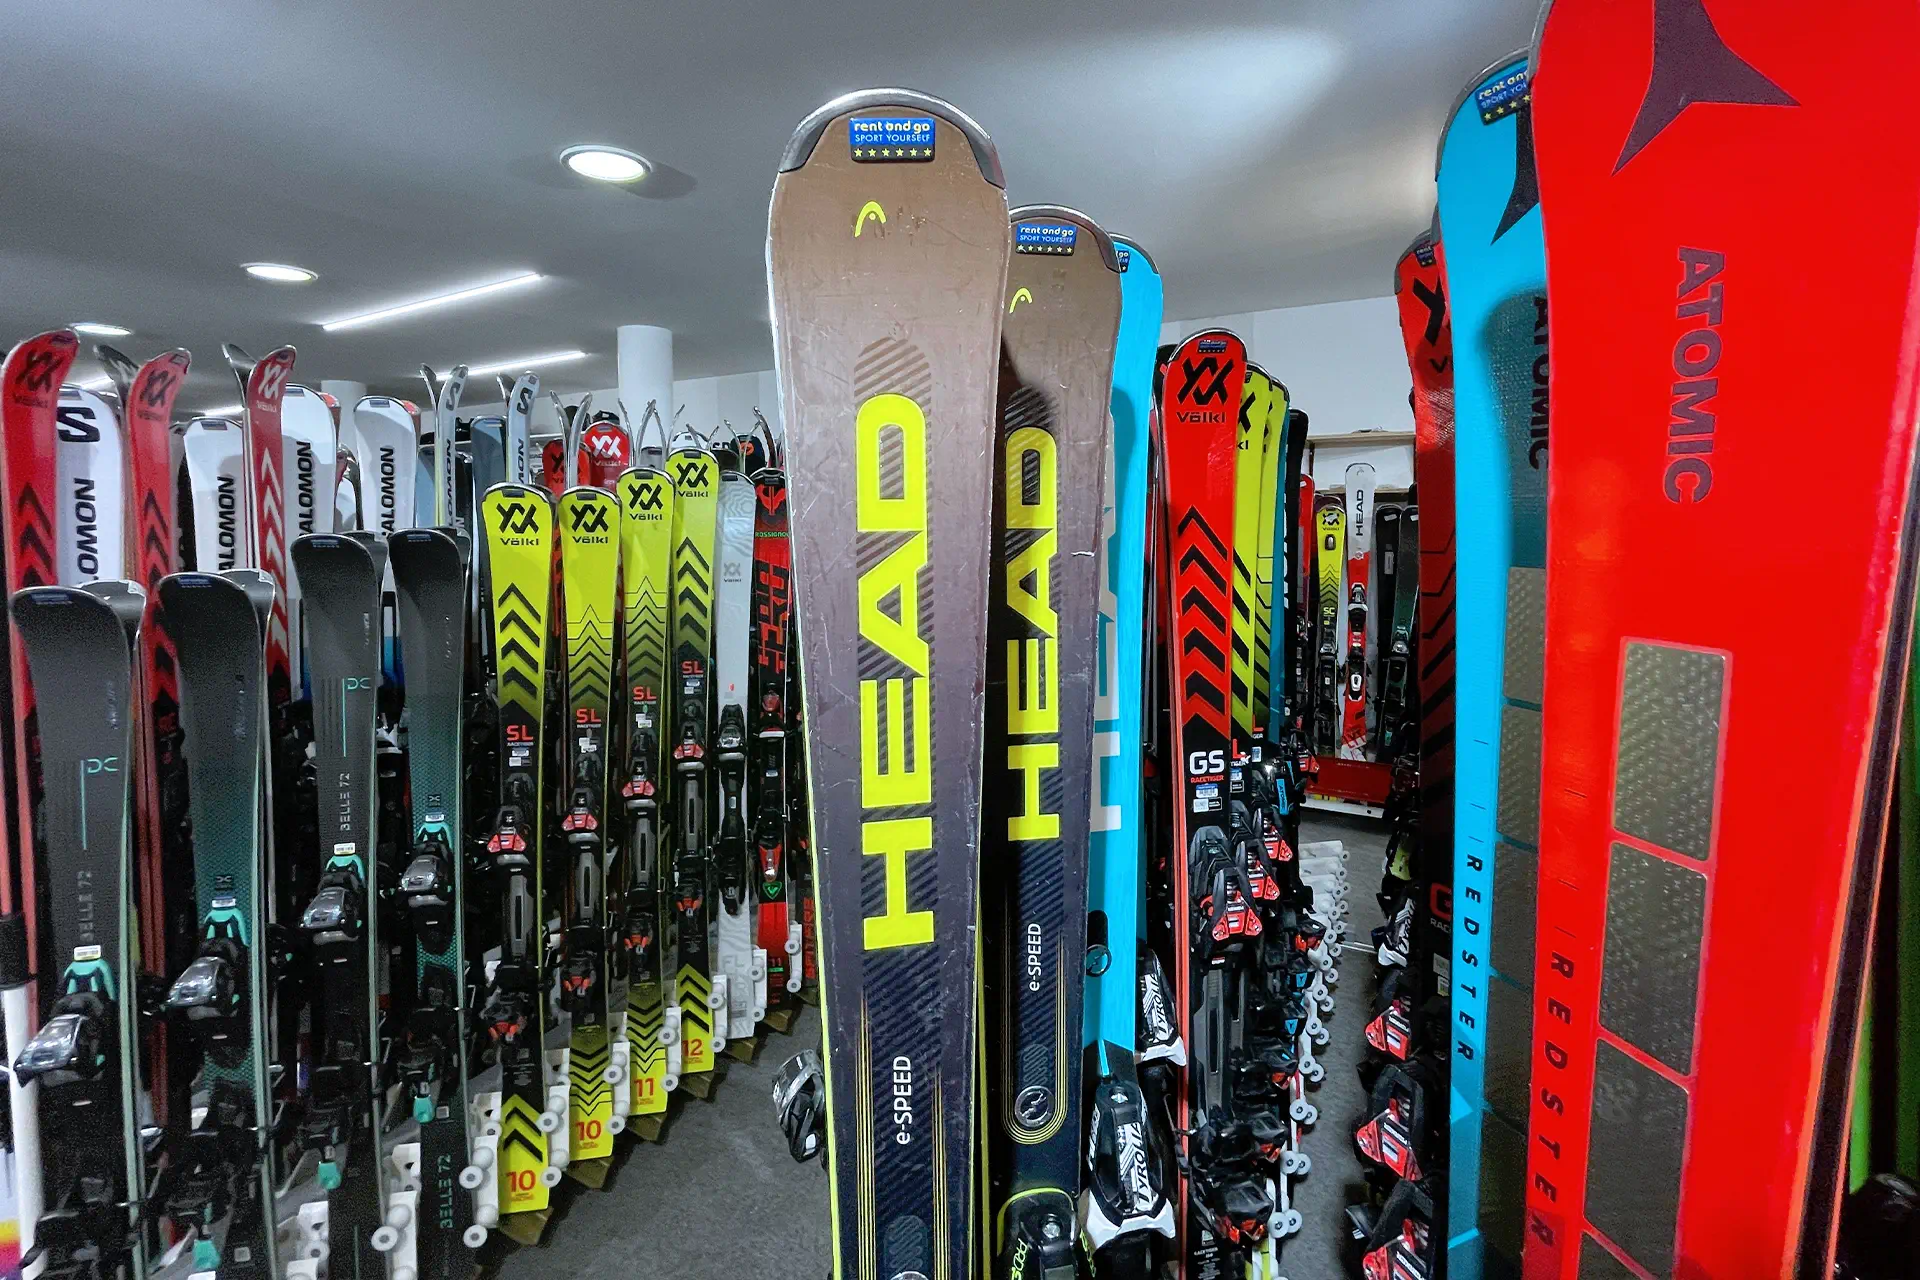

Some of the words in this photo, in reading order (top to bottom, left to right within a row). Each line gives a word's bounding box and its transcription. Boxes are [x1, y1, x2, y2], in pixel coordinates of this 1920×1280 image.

[1479, 81, 1505, 100] rent
[1507, 70, 1528, 85] an
[854, 121, 883, 131] rent
[886, 120, 911, 131] and
[913, 123, 931, 134] go
[855, 134, 883, 142] SPORT
[886, 134, 930, 142] YOURSELF
[1020, 226, 1041, 234] rent
[1042, 227, 1061, 235] and
[1662, 245, 1726, 505] ATOMIC
[1176, 412, 1227, 424] Völkl
[299, 441, 313, 535] ALOMON
[381, 447, 395, 536] ALOMON
[218, 476, 236, 570] ALOMON
[629, 513, 663, 521] Völkl
[1356, 489, 1364, 537] HEAD
[73, 478, 98, 576] OMON
[501, 538, 540, 546] Völkl
[572, 535, 609, 544] Völkl
[1005, 426, 1059, 842] HEAD
[681, 660, 704, 674] SL
[856, 393, 934, 950] HEAD
[633, 686, 657, 700] SL
[576, 708, 602, 723] SL
[506, 725, 534, 741] SL
[1189, 749, 1225, 775] GS
[1027, 923, 1042, 992] e-SPEED
[1457, 853, 1484, 1062] REDSTER
[682, 1038, 704, 1057] 12
[634, 1077, 655, 1097] 11
[893, 1055, 912, 1145] e-SPEED
[1529, 951, 1575, 1249] REDSTER
[576, 1119, 602, 1141] 10
[506, 1169, 537, 1192] 10
